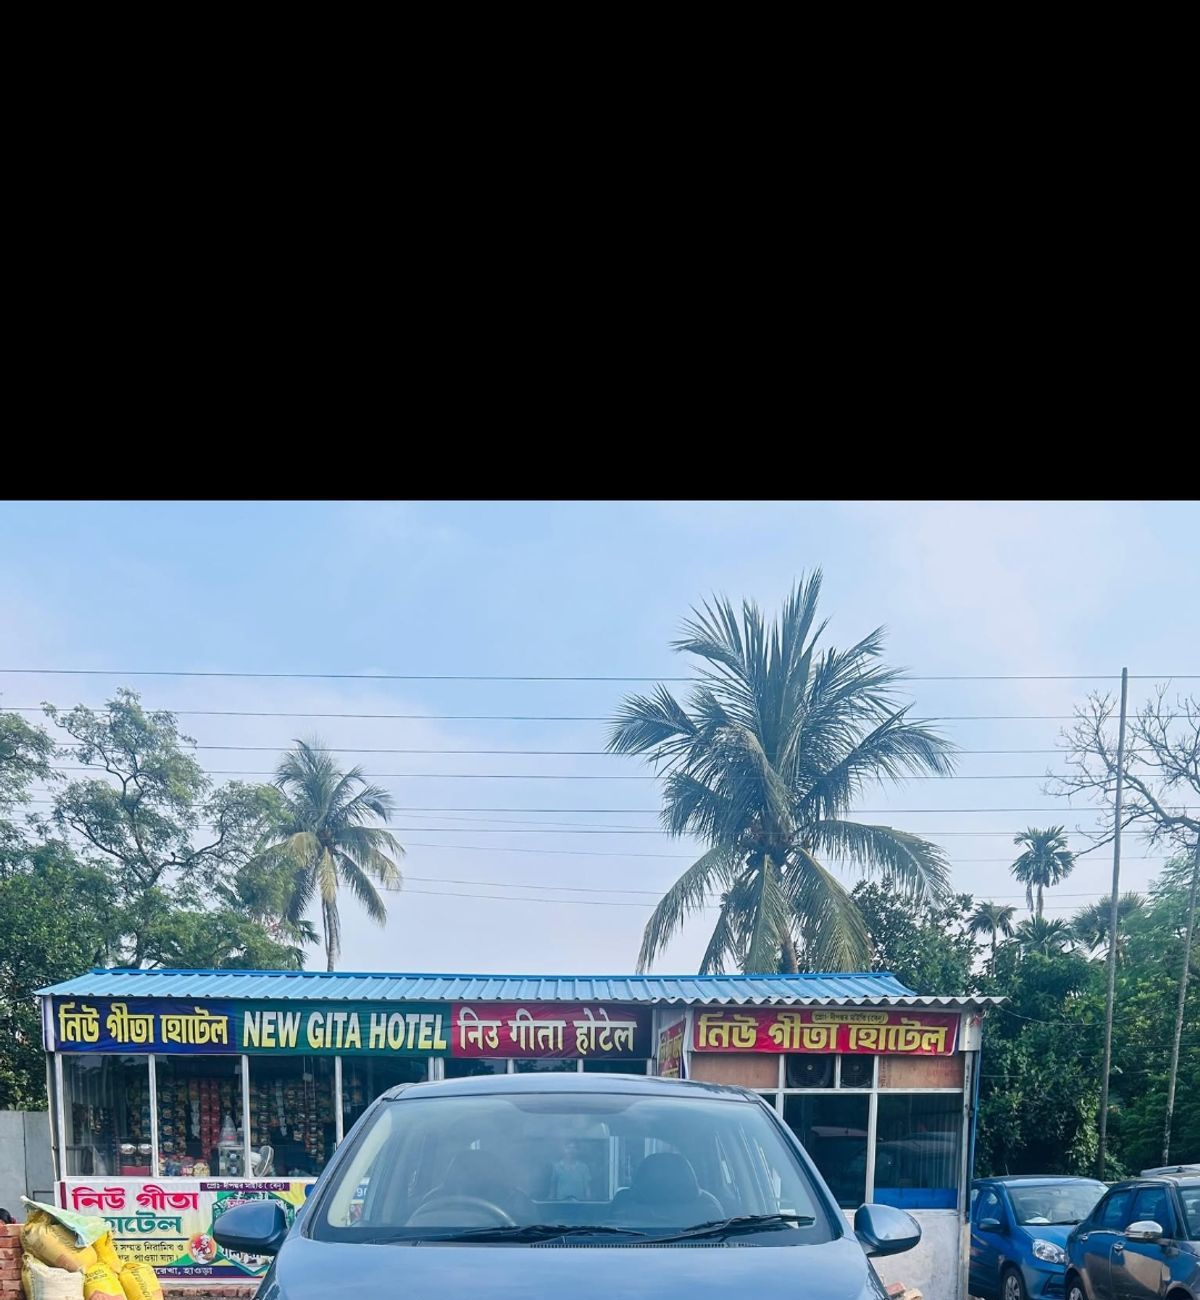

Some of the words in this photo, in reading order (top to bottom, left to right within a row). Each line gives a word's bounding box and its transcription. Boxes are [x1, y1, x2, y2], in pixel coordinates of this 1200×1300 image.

[58, 1002, 100, 1042] নিউ
[106, 1003, 155, 1043] গীতা
[160, 1006, 228, 1045] হোটেল
[243, 1011, 301, 1048] NEW
[306, 1011, 361, 1048] GITA
[369, 1012, 446, 1050] HOTEL
[457, 1006, 502, 1050] निउ
[507, 1007, 566, 1050] गीता
[573, 1007, 637, 1055] होटेल
[698, 1012, 759, 1048] নিউ
[768, 1012, 839, 1050] গীতা
[849, 1016, 949, 1052] হোটেল
[71, 1186, 126, 1211] নিউ
[136, 1184, 199, 1211] গীতা
